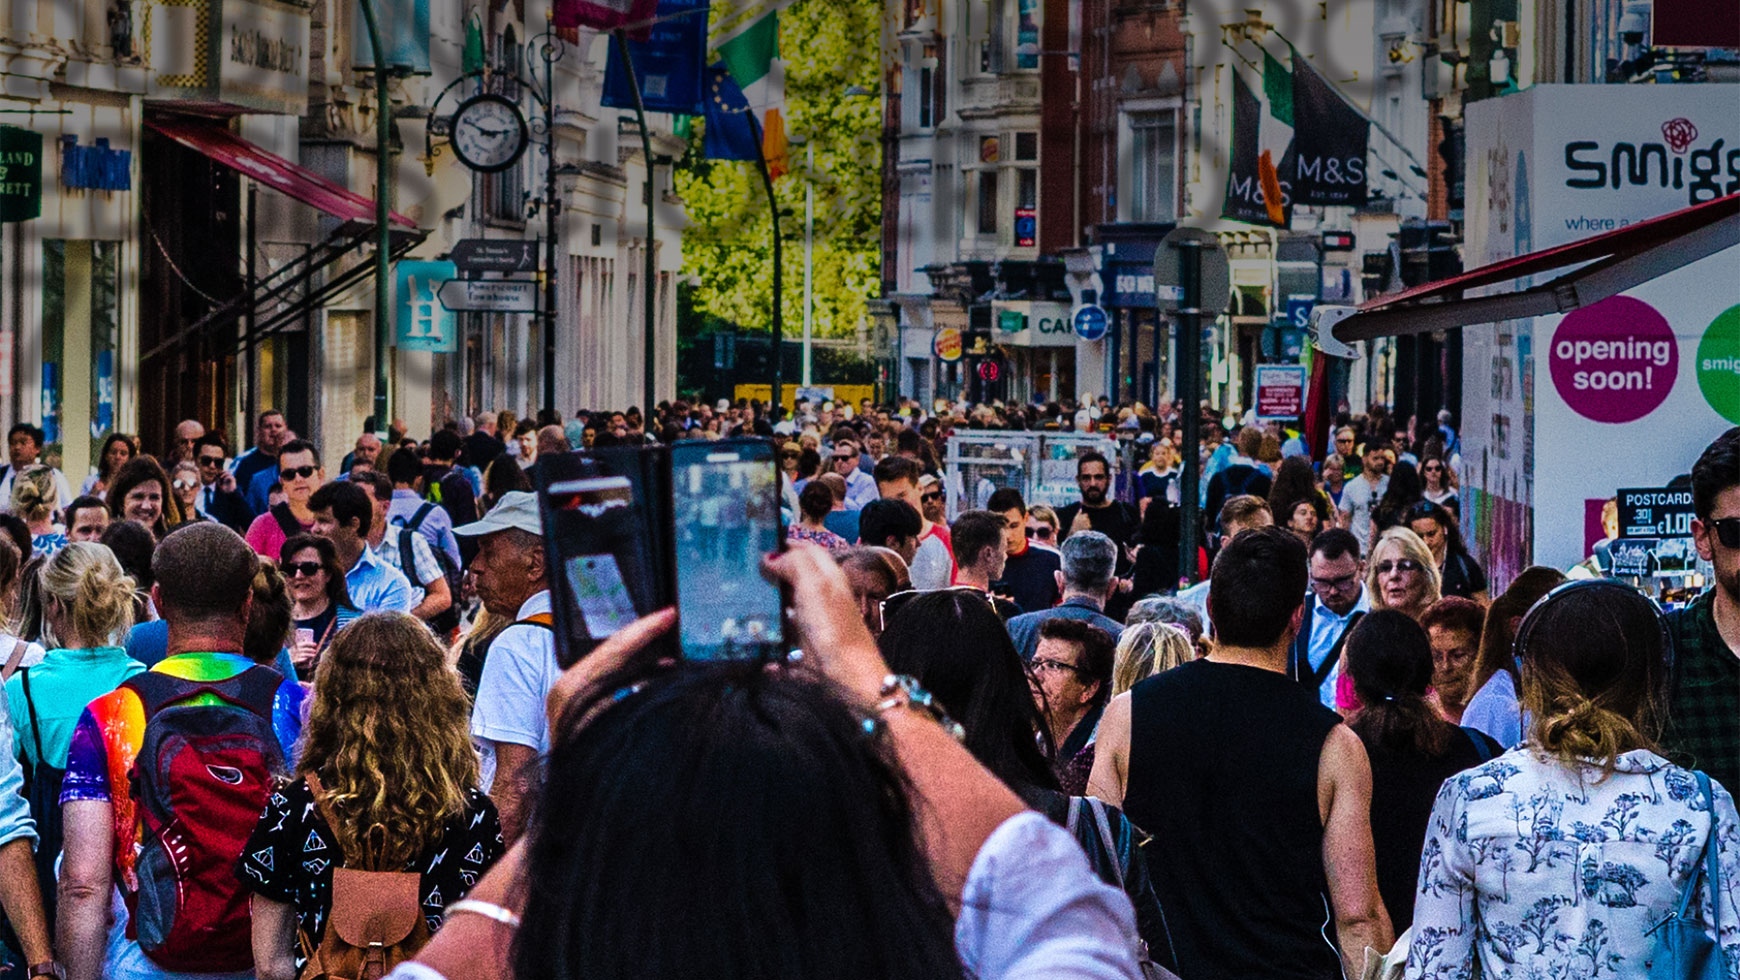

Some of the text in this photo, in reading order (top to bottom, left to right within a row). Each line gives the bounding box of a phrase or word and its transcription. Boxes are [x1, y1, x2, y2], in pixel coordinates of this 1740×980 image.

[1297, 153, 1364, 184] M&S
[1565, 216, 1615, 231] where
[406, 275, 443, 337] H
[1556, 336, 1670, 366] opening
[1573, 366, 1653, 390] soon!
[1626, 492, 1694, 507] POSTCARD
